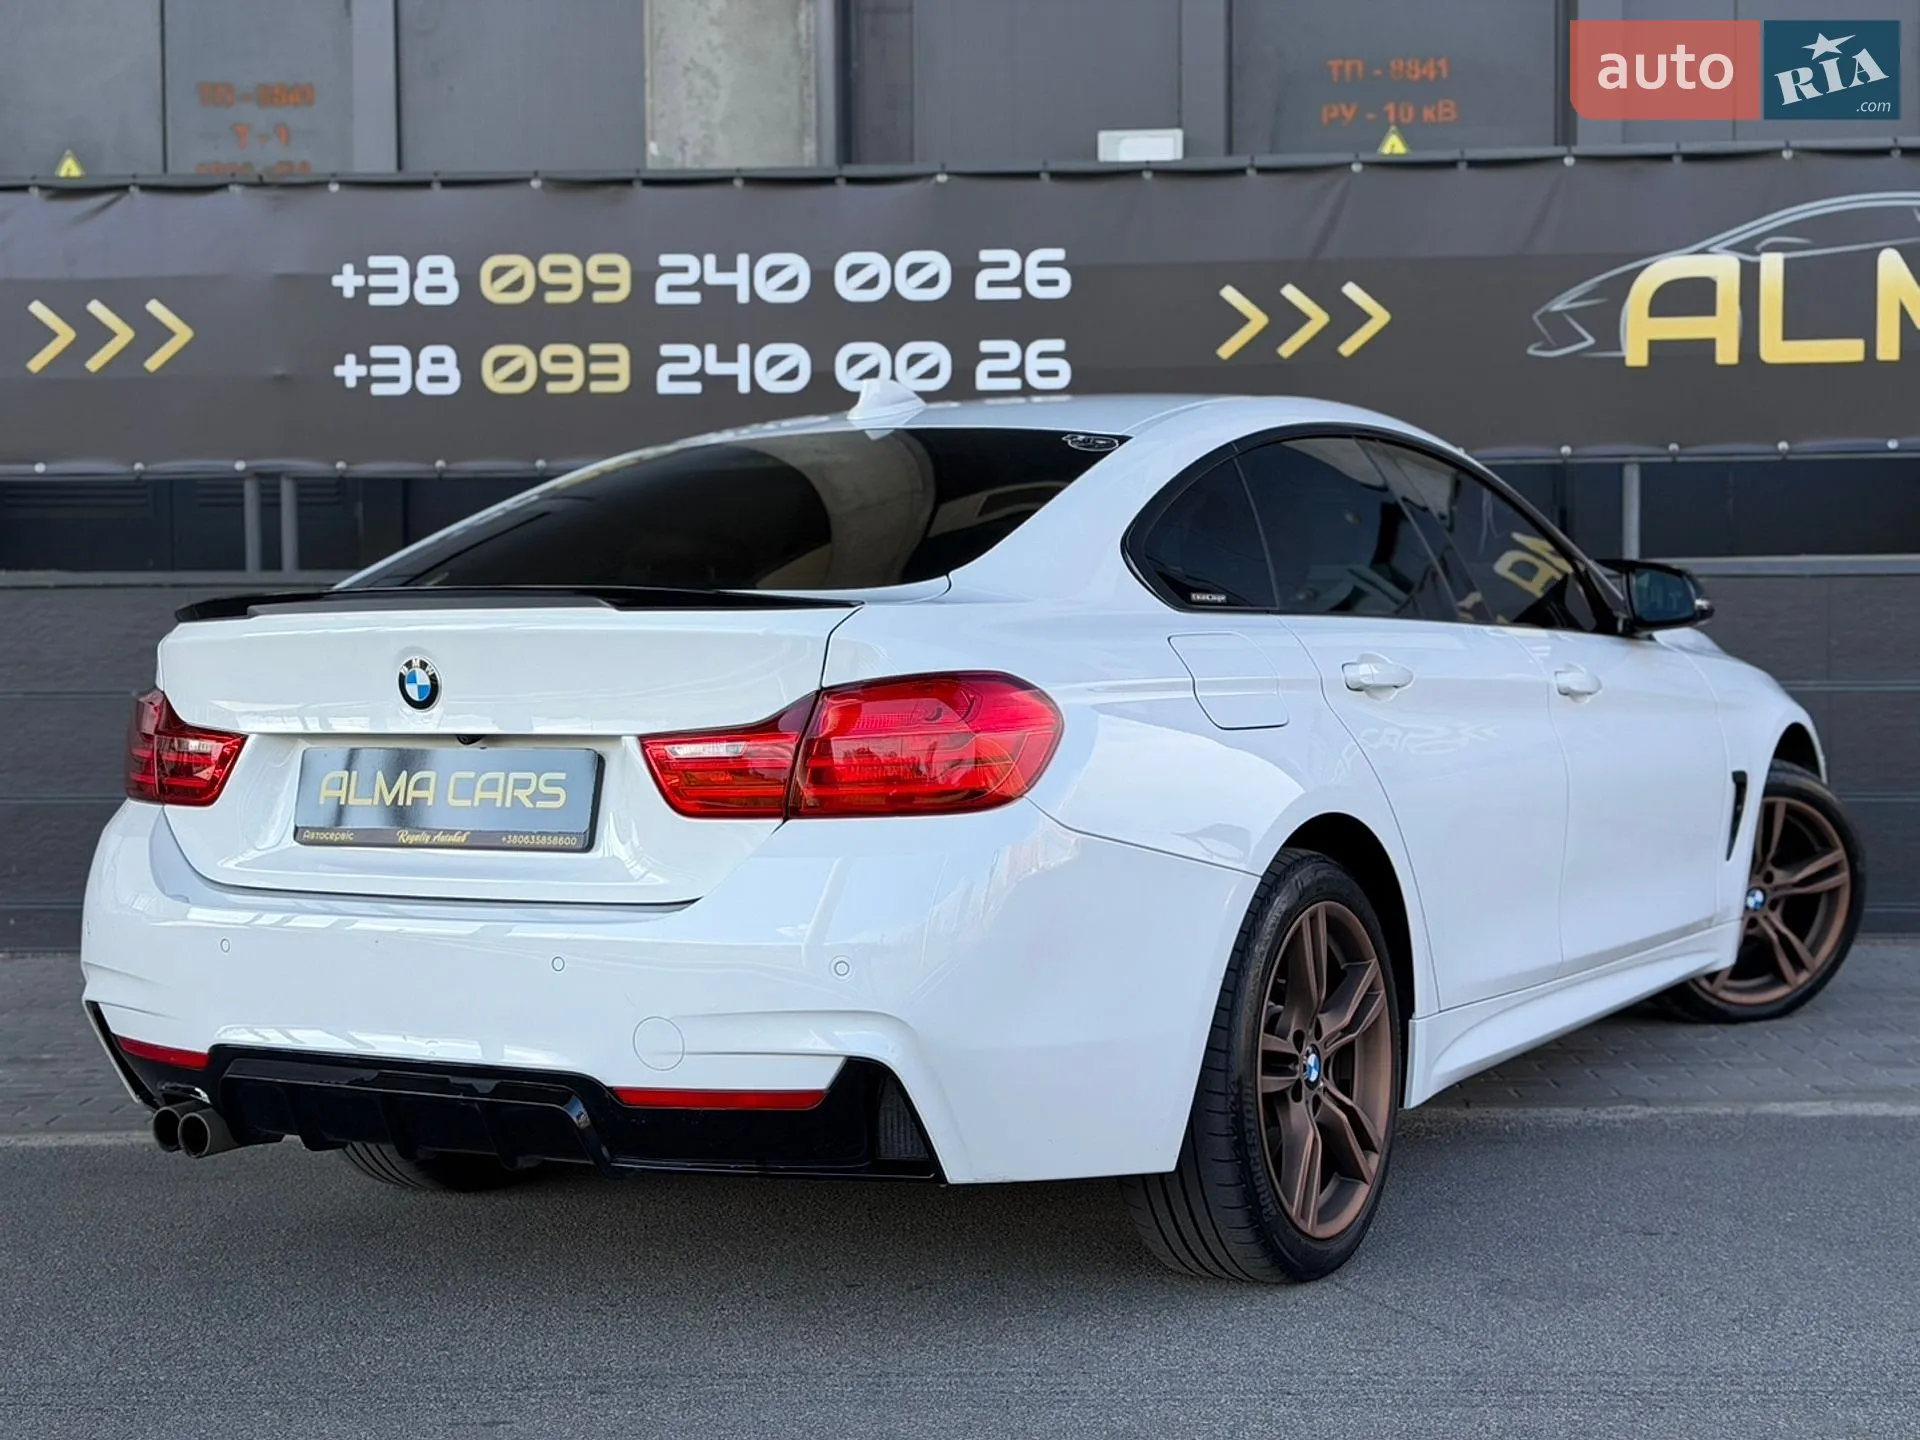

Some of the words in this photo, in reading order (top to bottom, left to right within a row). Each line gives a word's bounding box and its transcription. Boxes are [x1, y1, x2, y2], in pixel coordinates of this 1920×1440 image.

[1384, 101, 1415, 124] 10
[331, 254, 460, 306] +38
[480, 253, 632, 304] 099
[655, 252, 811, 304] 240
[834, 250, 952, 302] 00
[975, 248, 1072, 300] 26
[333, 344, 461, 396] +38
[481, 343, 631, 394] 093
[656, 342, 812, 395] 240
[835, 341, 952, 392] 00
[975, 339, 1072, 391] 26
[318, 770, 437, 808] ALMA
[447, 771, 568, 809] CARS
